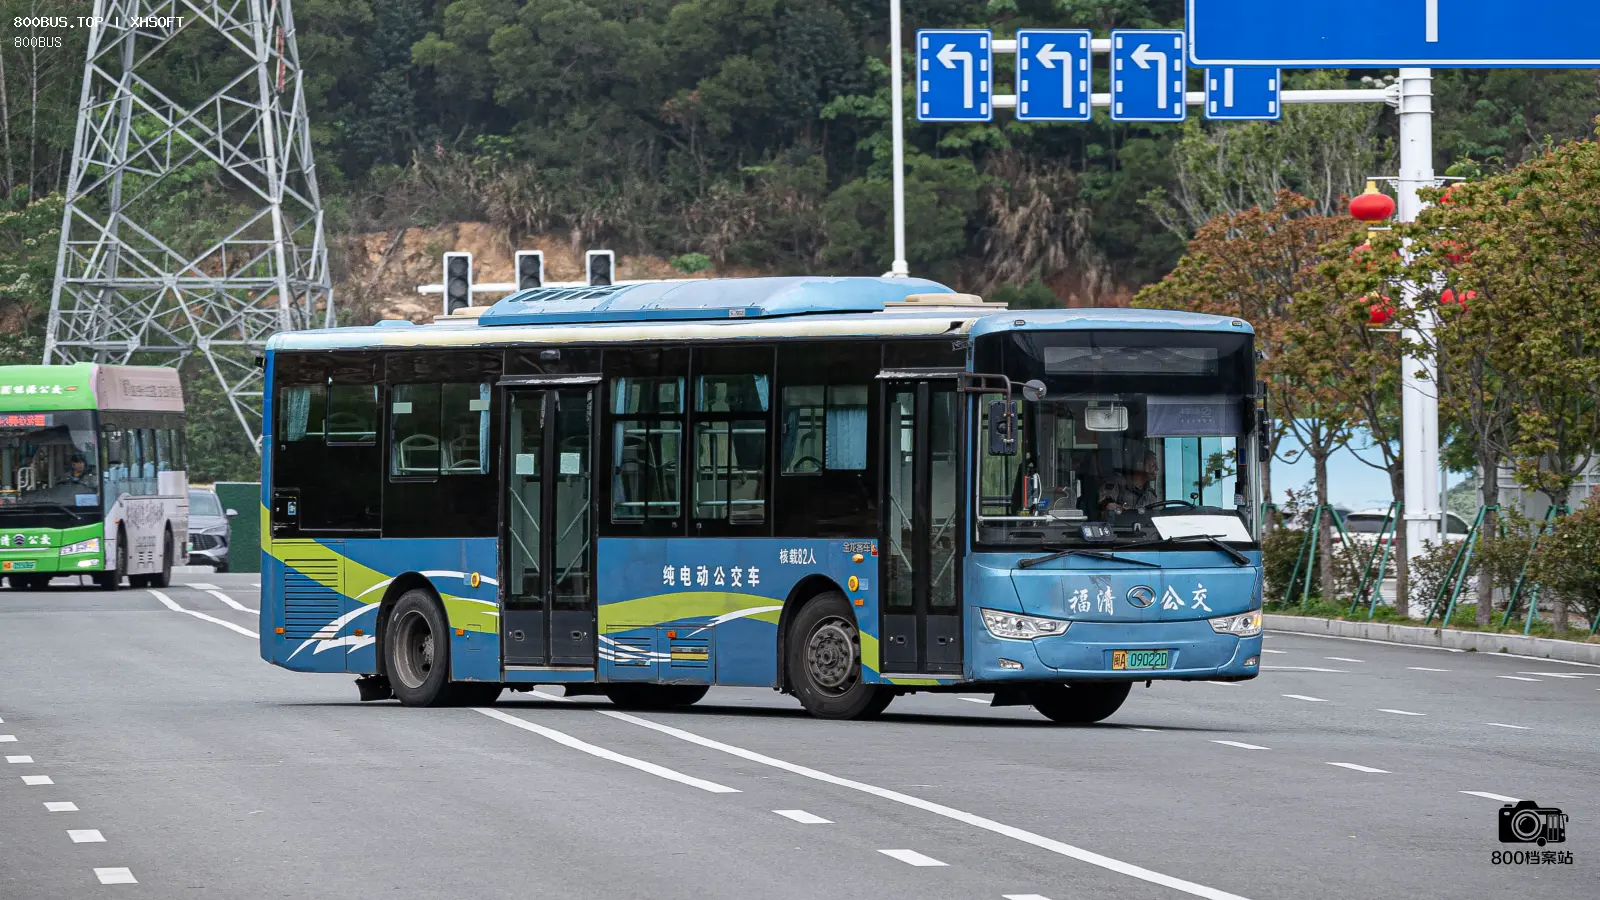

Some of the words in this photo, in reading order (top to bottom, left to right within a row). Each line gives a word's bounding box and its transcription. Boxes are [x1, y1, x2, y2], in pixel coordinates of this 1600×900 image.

[779, 548, 816, 565] 核载82人
[843, 541, 871, 553] 金龙客车
[662, 565, 760, 588] 纯电动公交车
[1067, 586, 1116, 616] 福清
[1159, 583, 1212, 613] 公交
